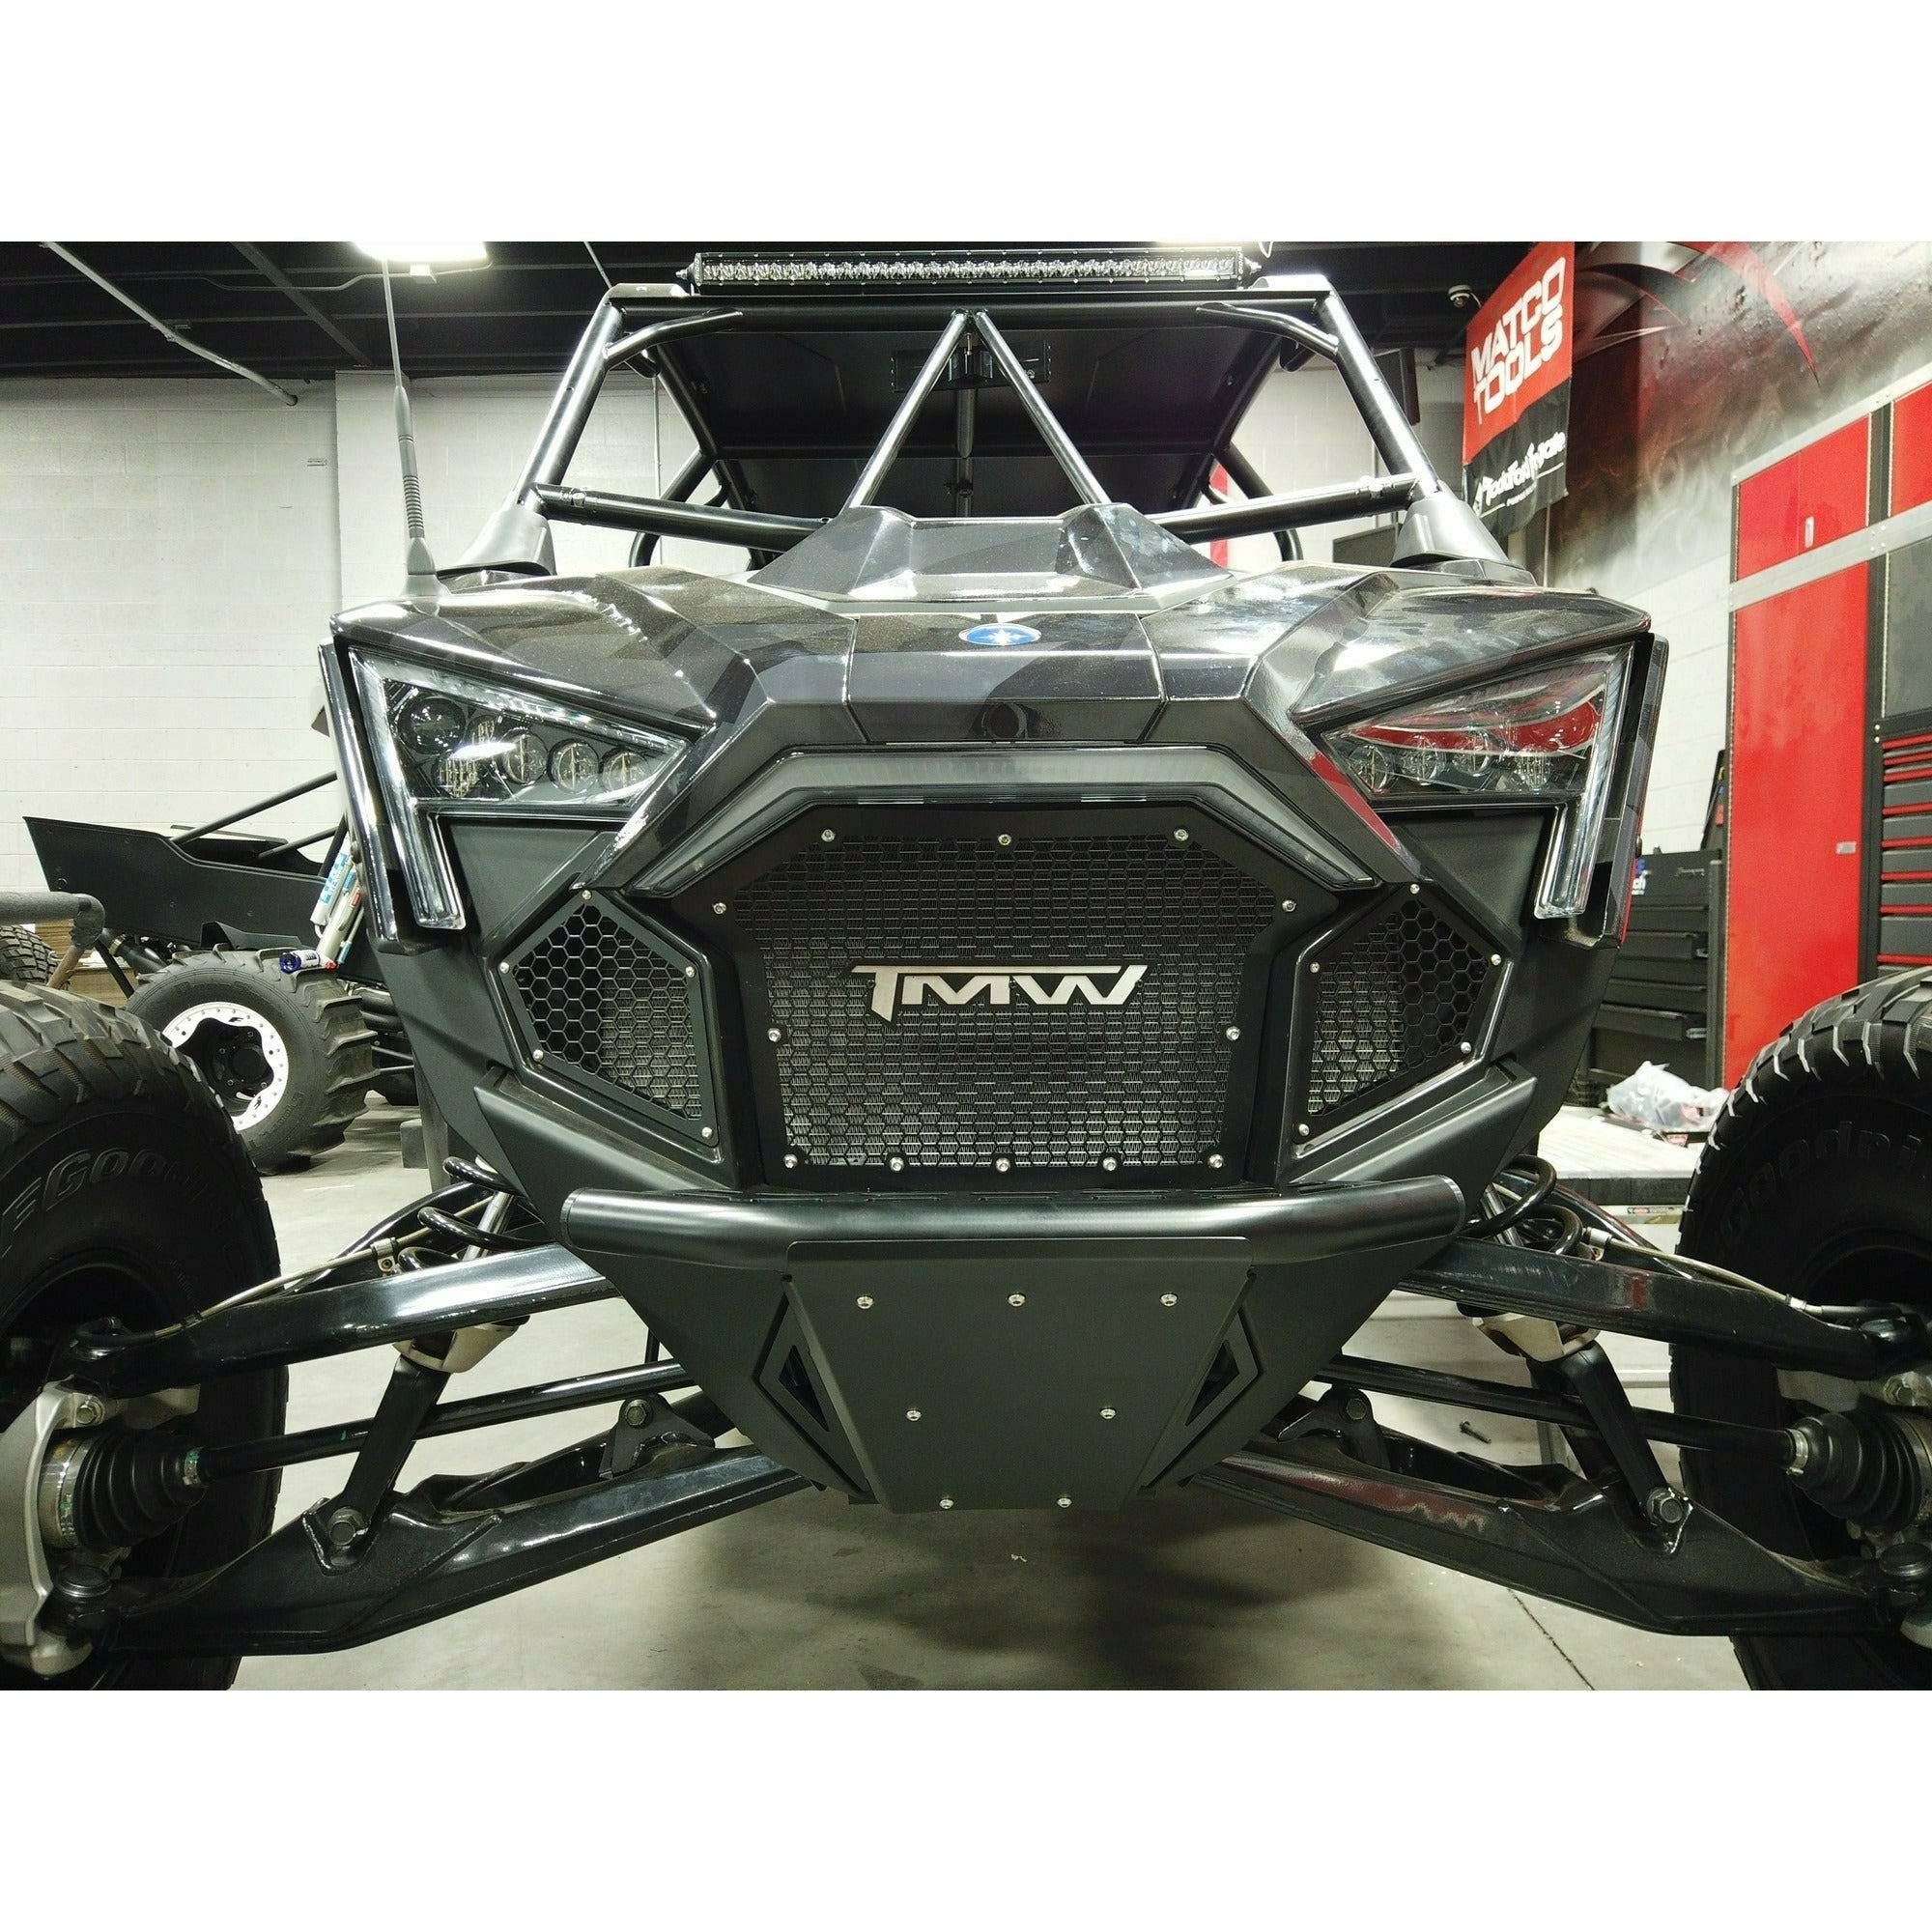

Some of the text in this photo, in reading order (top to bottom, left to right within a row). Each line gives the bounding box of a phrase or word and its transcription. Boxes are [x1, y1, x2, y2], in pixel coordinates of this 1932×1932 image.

[1470, 257, 1566, 385] MATCO
[1473, 303, 1563, 424] TOOLS
[851, 964, 1148, 1022] TMW
